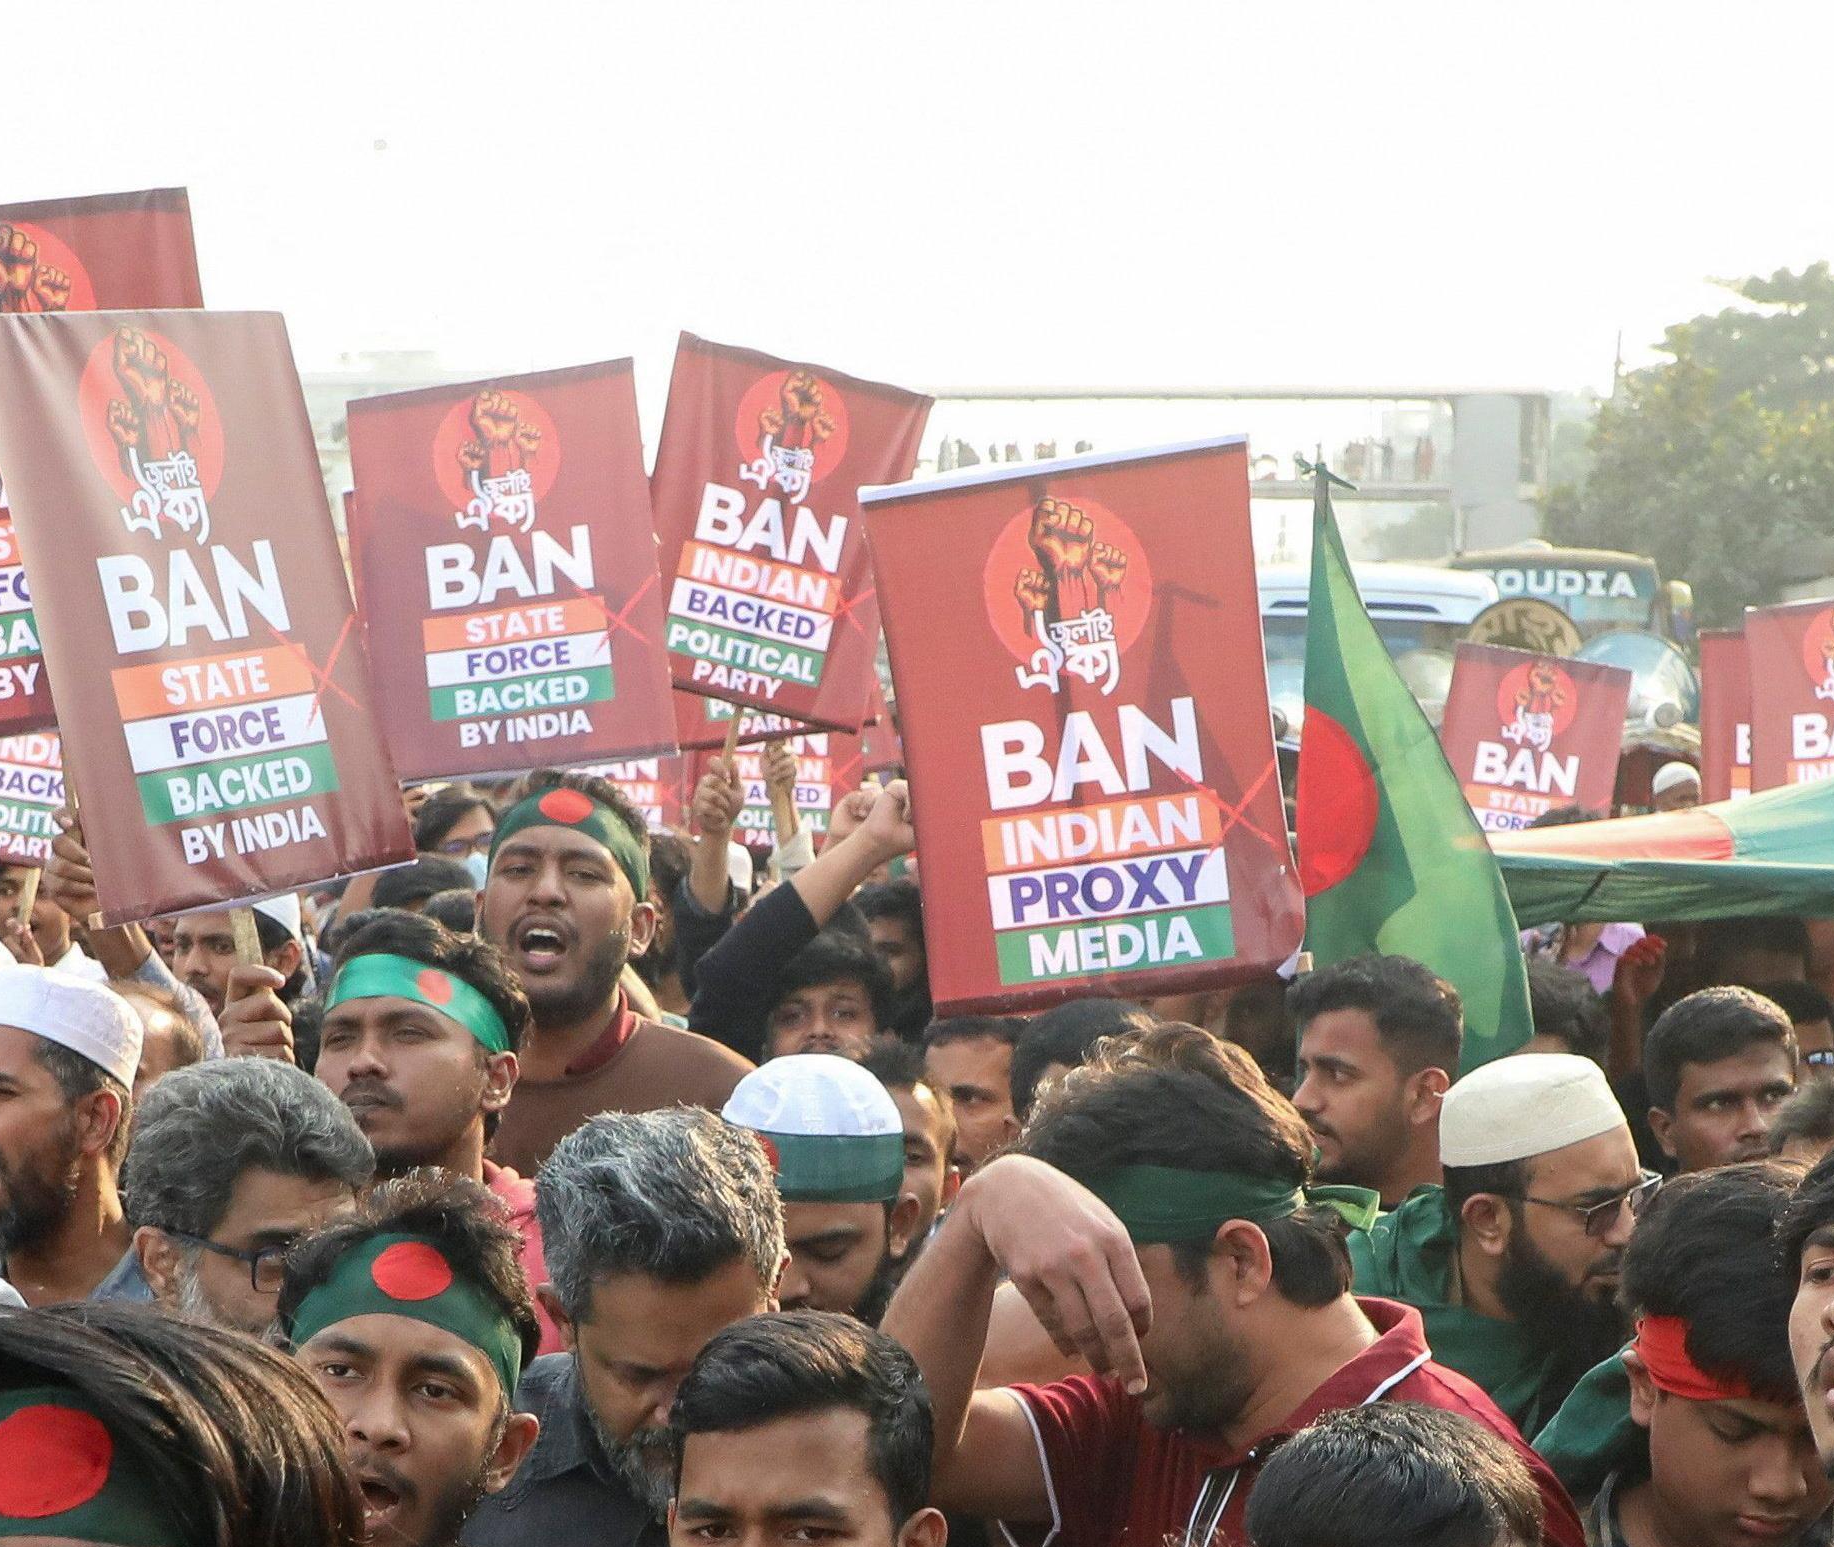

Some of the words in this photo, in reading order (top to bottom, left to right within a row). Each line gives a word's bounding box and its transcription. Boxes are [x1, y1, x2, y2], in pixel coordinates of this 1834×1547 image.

[121, 447, 211, 546] ঐক্য
[143, 451, 202, 491] জুলাই
[694, 481, 849, 574] BAN
[96, 539, 291, 655] BAN
[424, 523, 595, 610] BAN
[689, 547, 830, 609] INDIAN
[465, 605, 567, 645] STATE
[686, 587, 817, 641] BACKED
[1050, 606, 1116, 652] জুলাই
[161, 656, 270, 707] STATE
[467, 641, 571, 678] FORCE
[667, 622, 817, 683] POLITICAL
[691, 659, 784, 700] PARTY
[1014, 608, 1122, 697] ঐক্য
[454, 675, 591, 716] BACKED
[170, 706, 286, 759] FORCE
[458, 720, 502, 749] BY
[505, 708, 594, 744] INDIA
[979, 697, 1205, 811] BAN
[166, 756, 313, 818] BACKED
[1473, 741, 1580, 798] BAN
[180, 821, 225, 866] BY
[231, 805, 327, 856] INDIA
[999, 797, 1203, 867] INDIAN
[1009, 853, 1207, 925] PROXY
[1027, 915, 1204, 978] MEDIA
